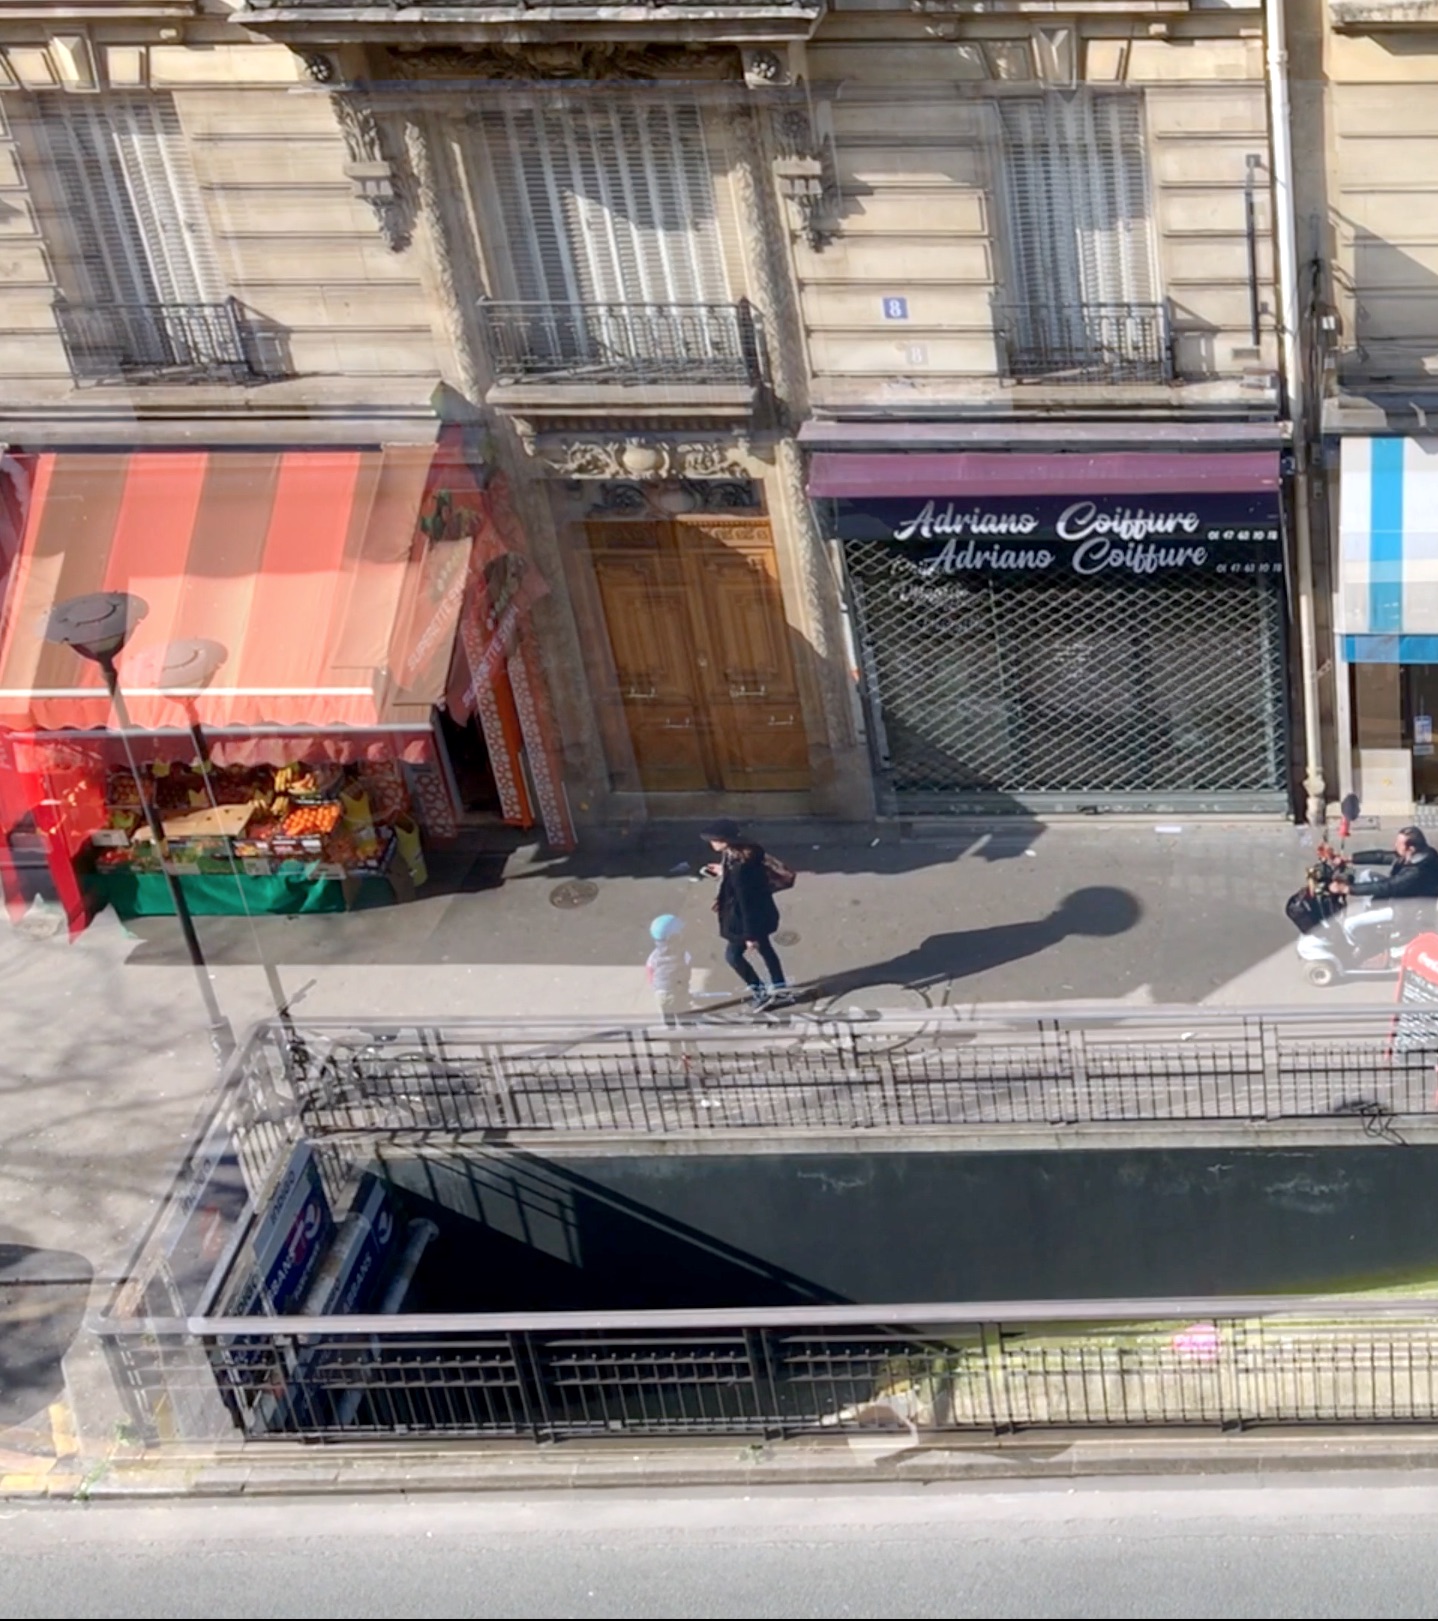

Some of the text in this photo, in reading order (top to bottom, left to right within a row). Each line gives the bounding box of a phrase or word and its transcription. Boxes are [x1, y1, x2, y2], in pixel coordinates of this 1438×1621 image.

[888, 298, 903, 318] 8
[893, 500, 1200, 541] Adriano Coiffure
[922, 538, 1056, 574] Adriano
[1071, 537, 1208, 575] Coiffure
